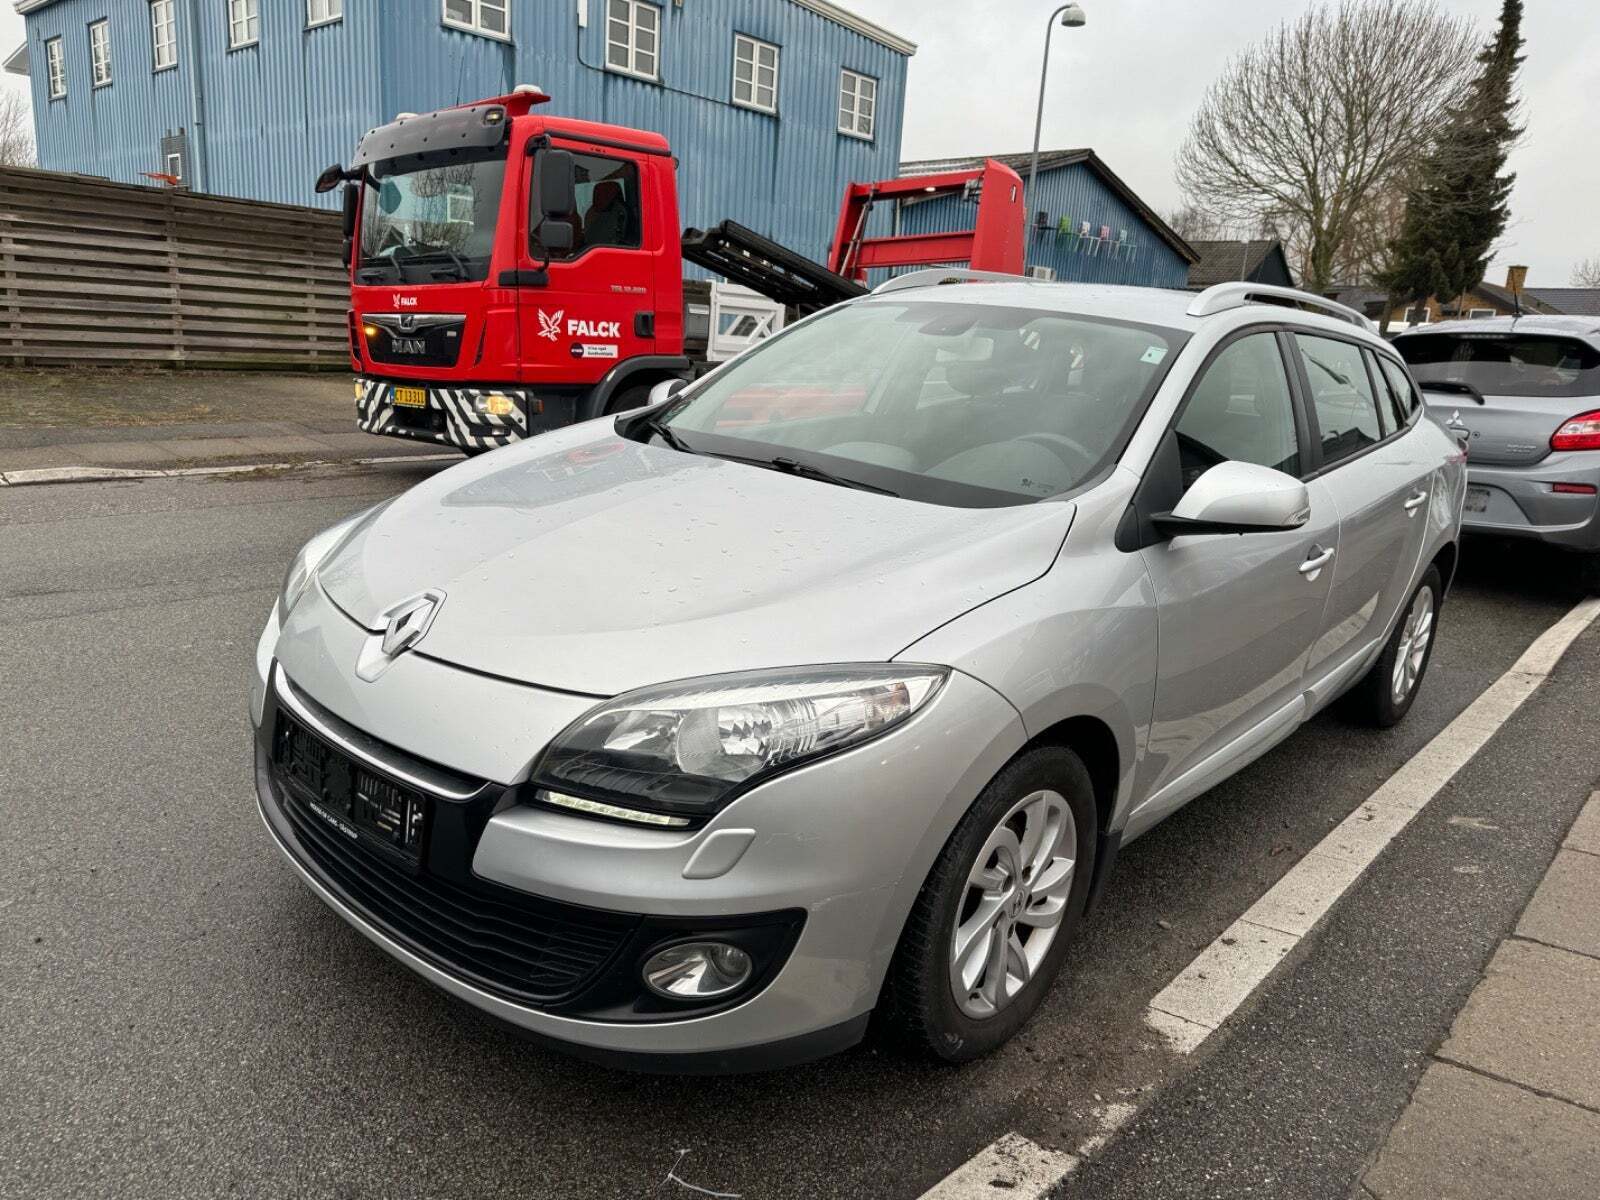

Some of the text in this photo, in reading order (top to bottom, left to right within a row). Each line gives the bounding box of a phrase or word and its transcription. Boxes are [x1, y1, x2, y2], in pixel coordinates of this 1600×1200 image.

[400, 296, 418, 306] FALCK
[567, 319, 621, 338] FALCK
[391, 339, 426, 354] MAN
